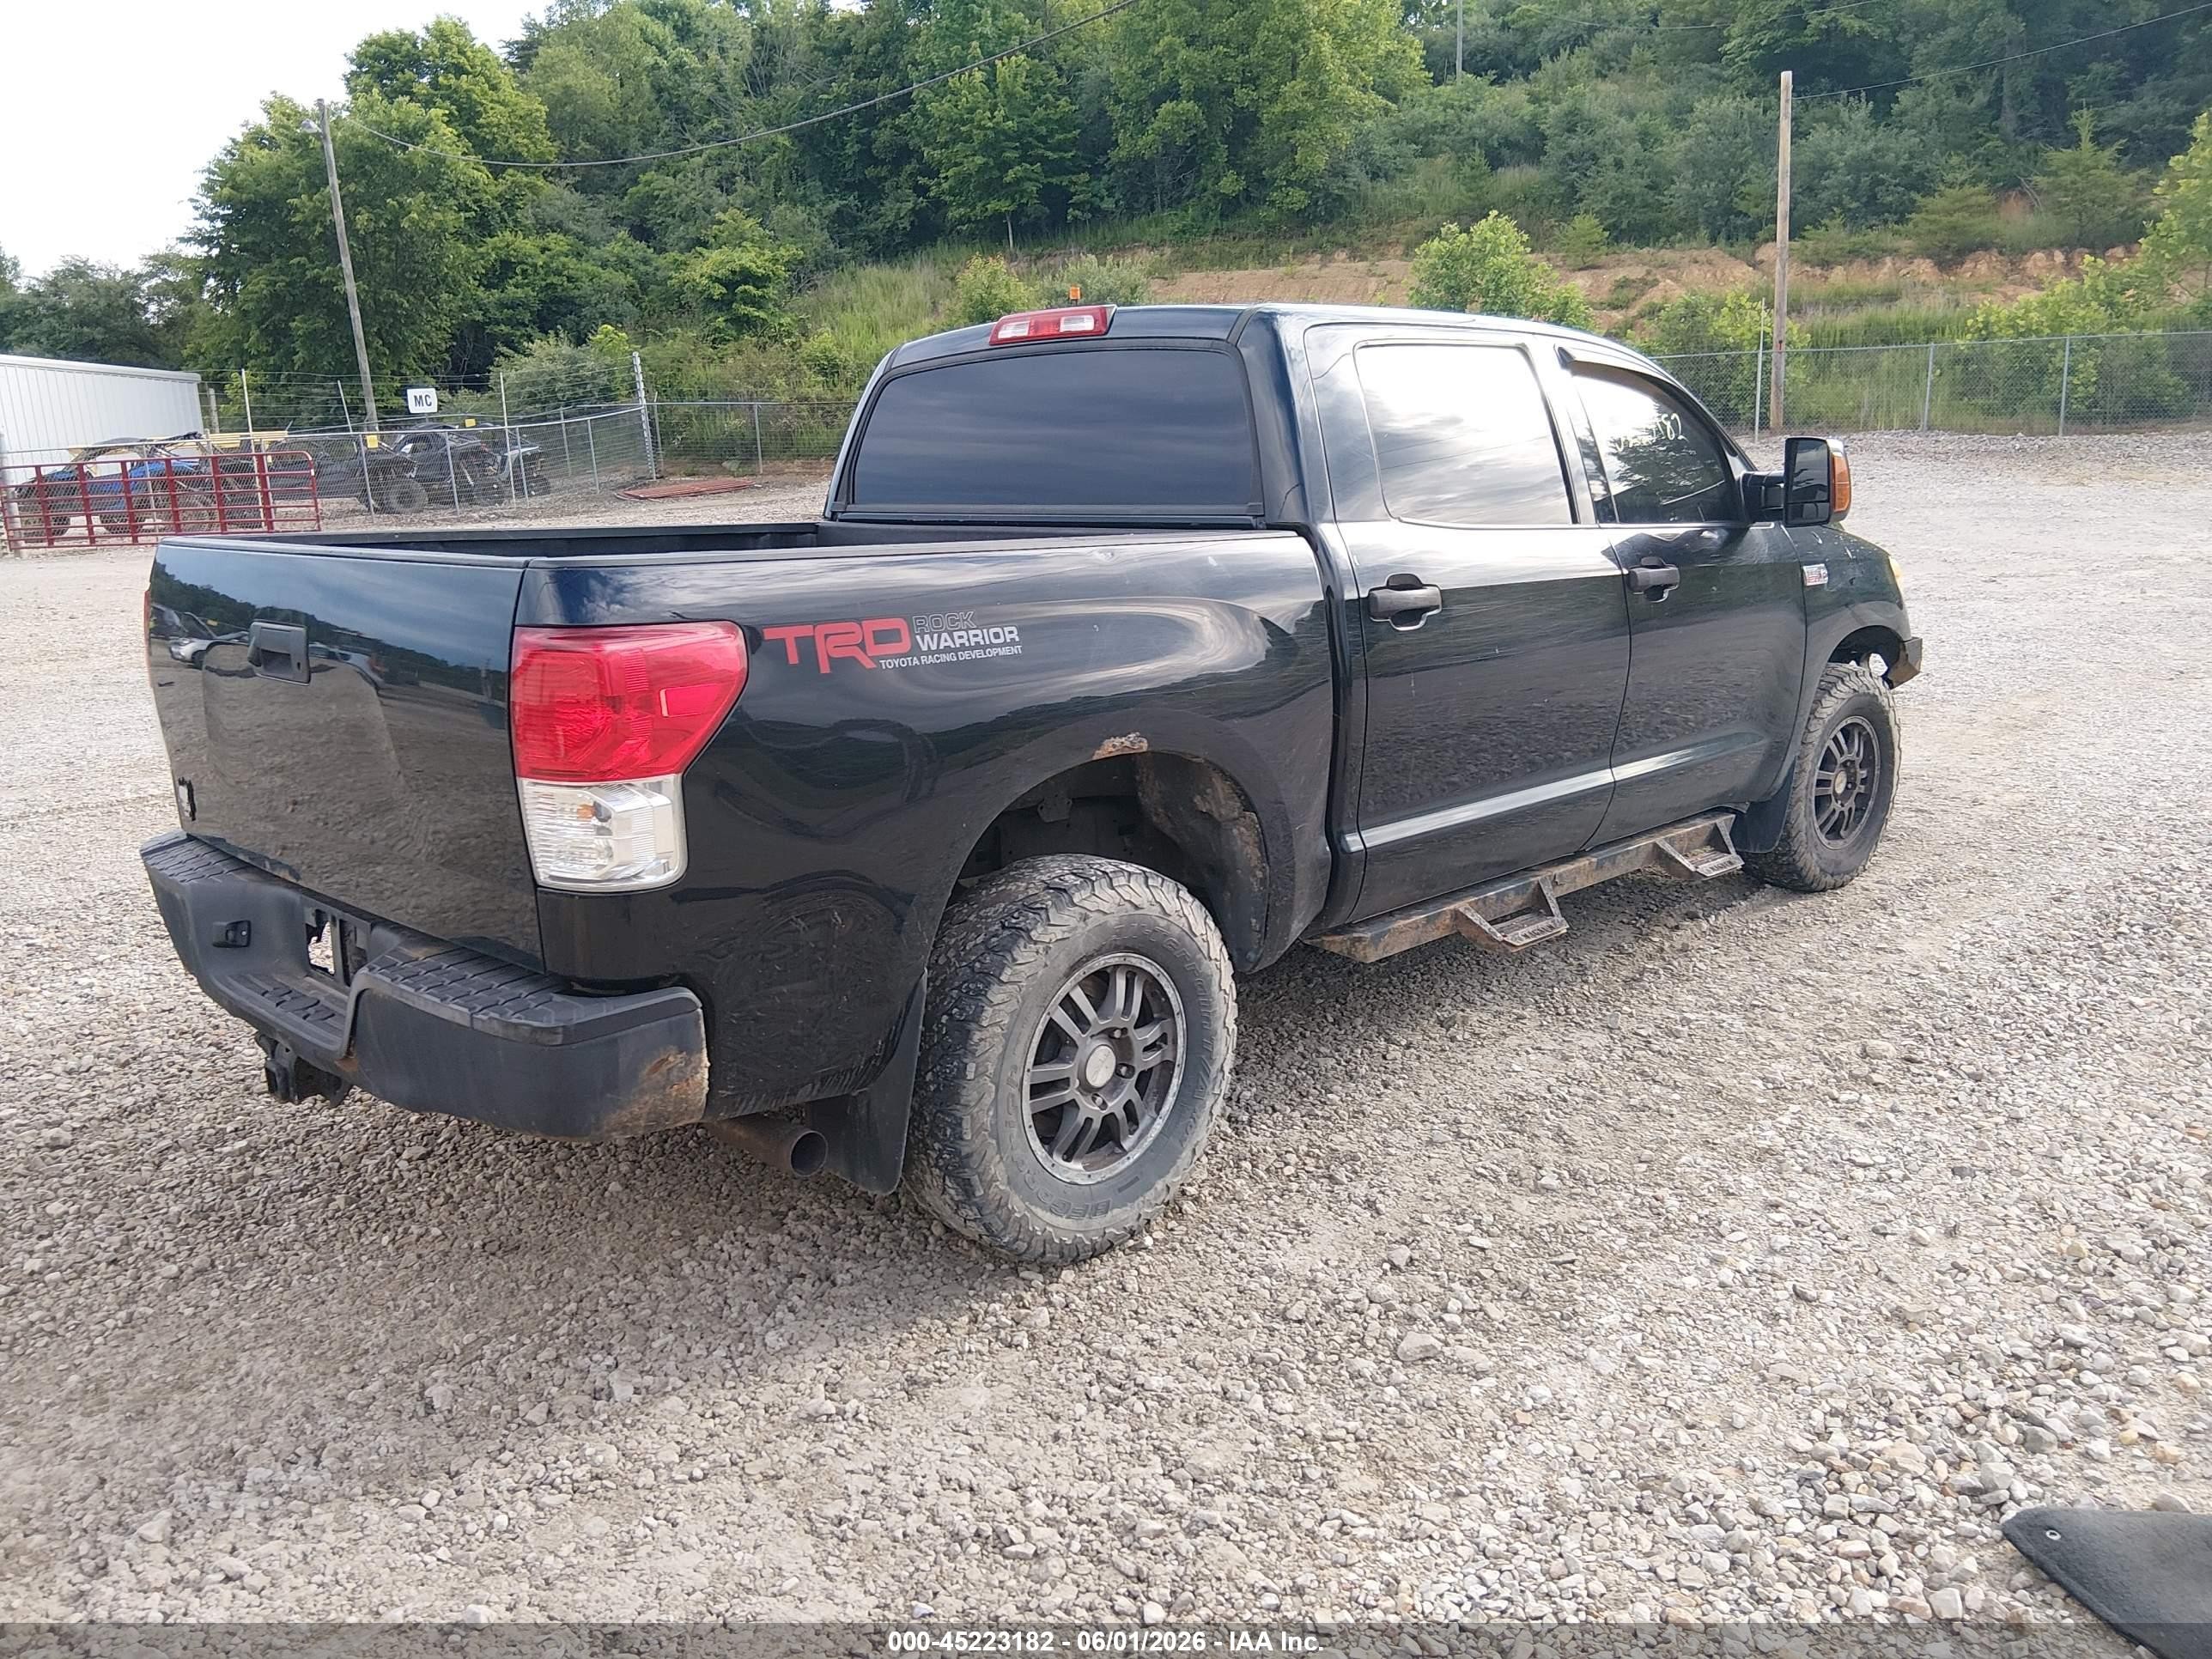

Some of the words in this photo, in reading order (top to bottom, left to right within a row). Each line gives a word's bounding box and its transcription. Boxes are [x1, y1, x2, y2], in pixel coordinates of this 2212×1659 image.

[413, 394, 433, 407] MC
[912, 610, 976, 635] ROCK
[763, 617, 911, 674] TRD
[915, 625, 1020, 652] WARRIOR
[879, 656, 920, 670] TOYOTA
[920, 652, 958, 666] RACING
[957, 644, 1022, 663] DEVELOPMENT
